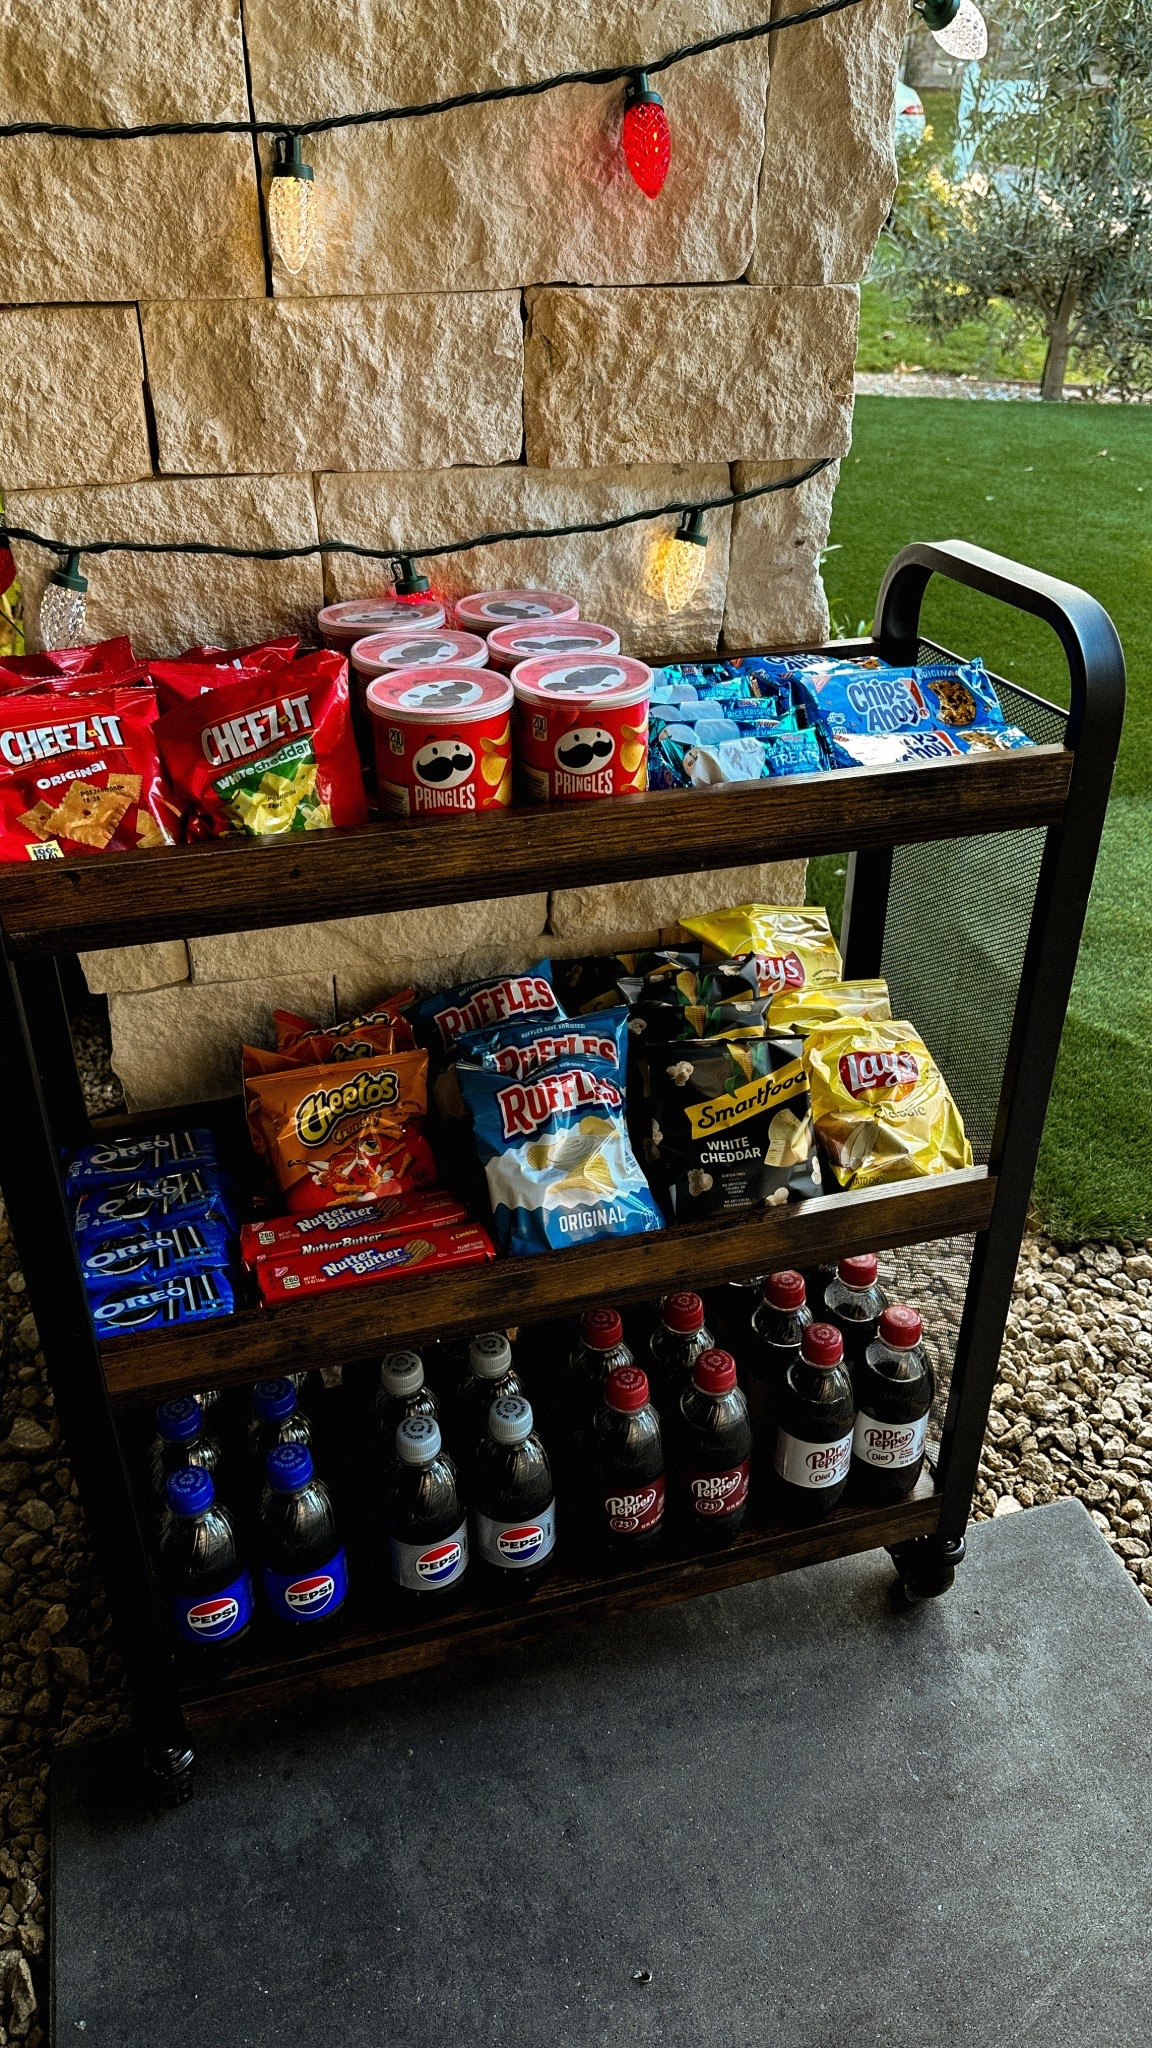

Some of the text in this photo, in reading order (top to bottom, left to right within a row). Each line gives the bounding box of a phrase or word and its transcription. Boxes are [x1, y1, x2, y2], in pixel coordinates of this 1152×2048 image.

[919, 669, 959, 680] ORIGINA
[849, 679, 909, 713] Chips
[727, 711, 743, 719] RICE
[255, 743, 309, 772] cheddar
[772, 751, 820, 767] TREATS
[554, 769, 613, 796] PRINGLES
[414, 783, 476, 811] PRINGLES
[437, 979, 555, 1046] RUFFLES
[299, 1072, 395, 1142] Cheetos
[697, 1070, 808, 1129] Smartfood
[333, 1111, 380, 1143] Crunchy
[90, 1140, 170, 1165] OREO
[700, 1147, 762, 1164] CHEDDAR
[707, 1137, 750, 1151] WHITE
[98, 1185, 178, 1214] OREO
[92, 1218, 101, 1226] 4
[296, 1207, 346, 1232] Nutter
[324, 1206, 374, 1230] Butter
[559, 1205, 627, 1233] ORIGINAL
[85, 1238, 174, 1269] OREO
[301, 1233, 382, 1256] Nutter Butter
[322, 1249, 374, 1277] Nutter
[352, 1248, 402, 1275] Butter
[284, 1276, 299, 1284] 260
[93, 1286, 186, 1319] OREO
[864, 1429, 912, 1450] Pepper
[883, 1430, 902, 1440] Dr
[806, 1443, 849, 1470] Pepper
[825, 1444, 842, 1459] Dr
[871, 1453, 889, 1461] Diet
[691, 1475, 739, 1499] Pepper
[709, 1477, 729, 1488] Dr
[814, 1472, 832, 1482] Diet
[605, 1493, 654, 1517] Pepper
[624, 1494, 643, 1506] Dr
[499, 1533, 542, 1549] PEPSI
[418, 1548, 460, 1572] PEPSI
[287, 1582, 332, 1602] PEPSI
[190, 1603, 236, 1625] PEPSI
